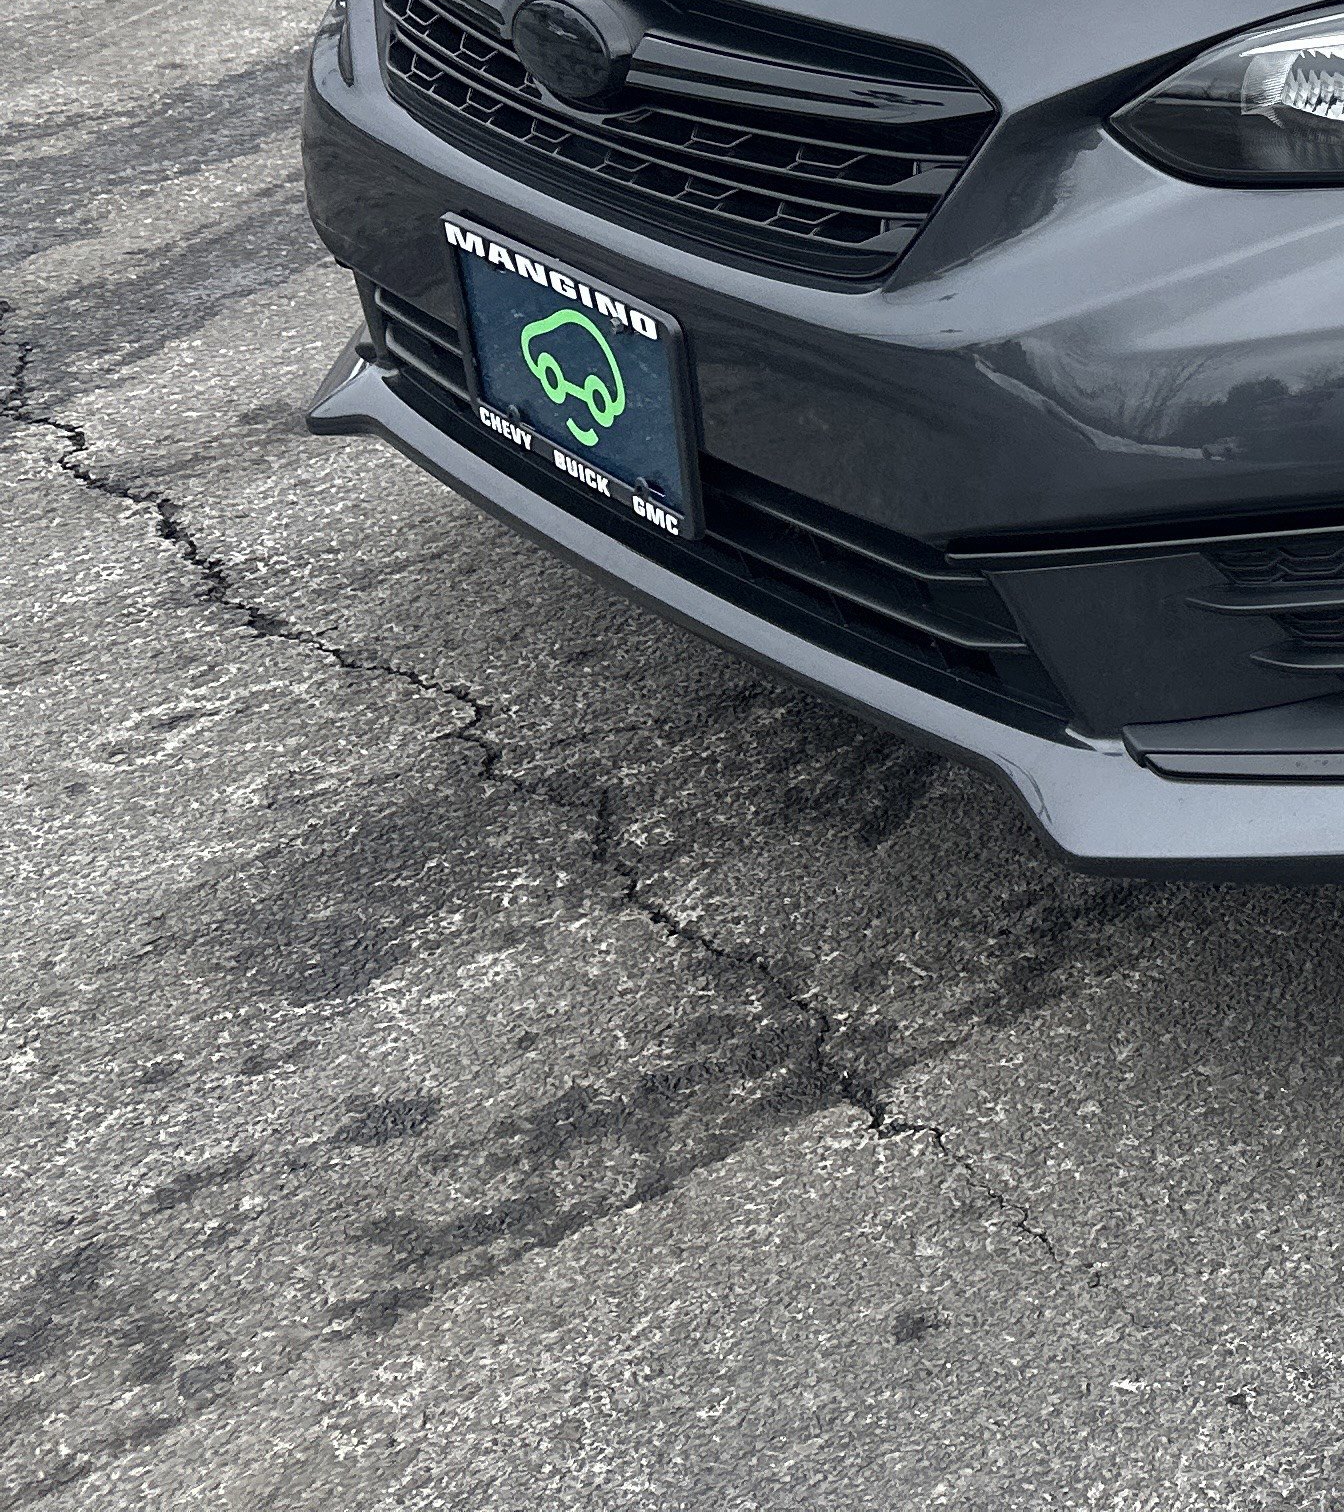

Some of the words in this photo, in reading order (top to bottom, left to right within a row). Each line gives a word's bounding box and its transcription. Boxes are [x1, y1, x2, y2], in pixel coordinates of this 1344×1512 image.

[444, 221, 658, 340] MANGINO
[479, 406, 532, 451] CHEVY
[553, 449, 611, 497] BUICK
[632, 495, 679, 536] GMC
